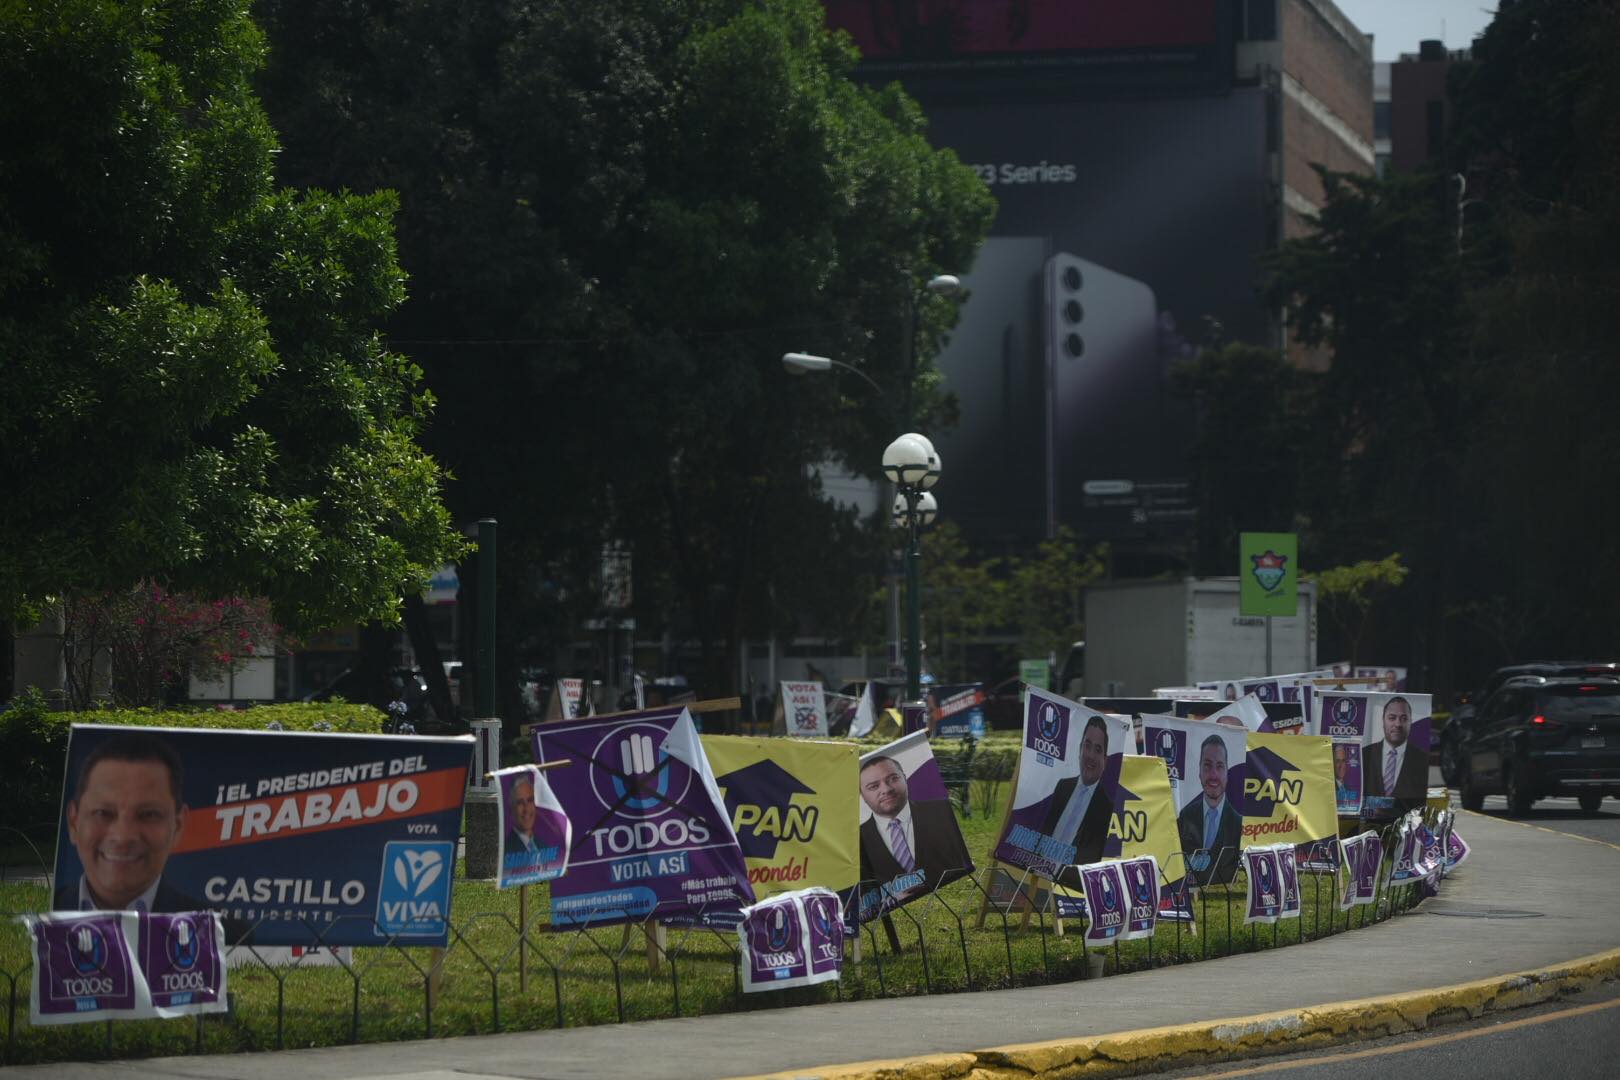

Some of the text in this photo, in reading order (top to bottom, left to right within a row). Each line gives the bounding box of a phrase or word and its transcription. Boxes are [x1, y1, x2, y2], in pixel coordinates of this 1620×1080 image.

[1000, 160, 1077, 184] Series
[1328, 725, 1358, 735] TODOS
[1034, 737, 1061, 758] TODOS
[256, 761, 384, 797] PRESIDENTE
[388, 755, 428, 775] DEL
[1243, 778, 1303, 805] PAN
[215, 780, 420, 842] TRABAJO
[407, 824, 438, 835] VOTA
[733, 804, 819, 843] PAN
[590, 816, 711, 857] TODOS
[612, 851, 688, 882] VOTA ASÍ
[203, 876, 366, 905] CASTILLO
[706, 874, 737, 888] trabajo
[382, 901, 441, 923] VIVA
[1101, 911, 1120, 926] TODOS
[762, 953, 796, 968] TODOS
[162, 970, 206, 991] TODOS
